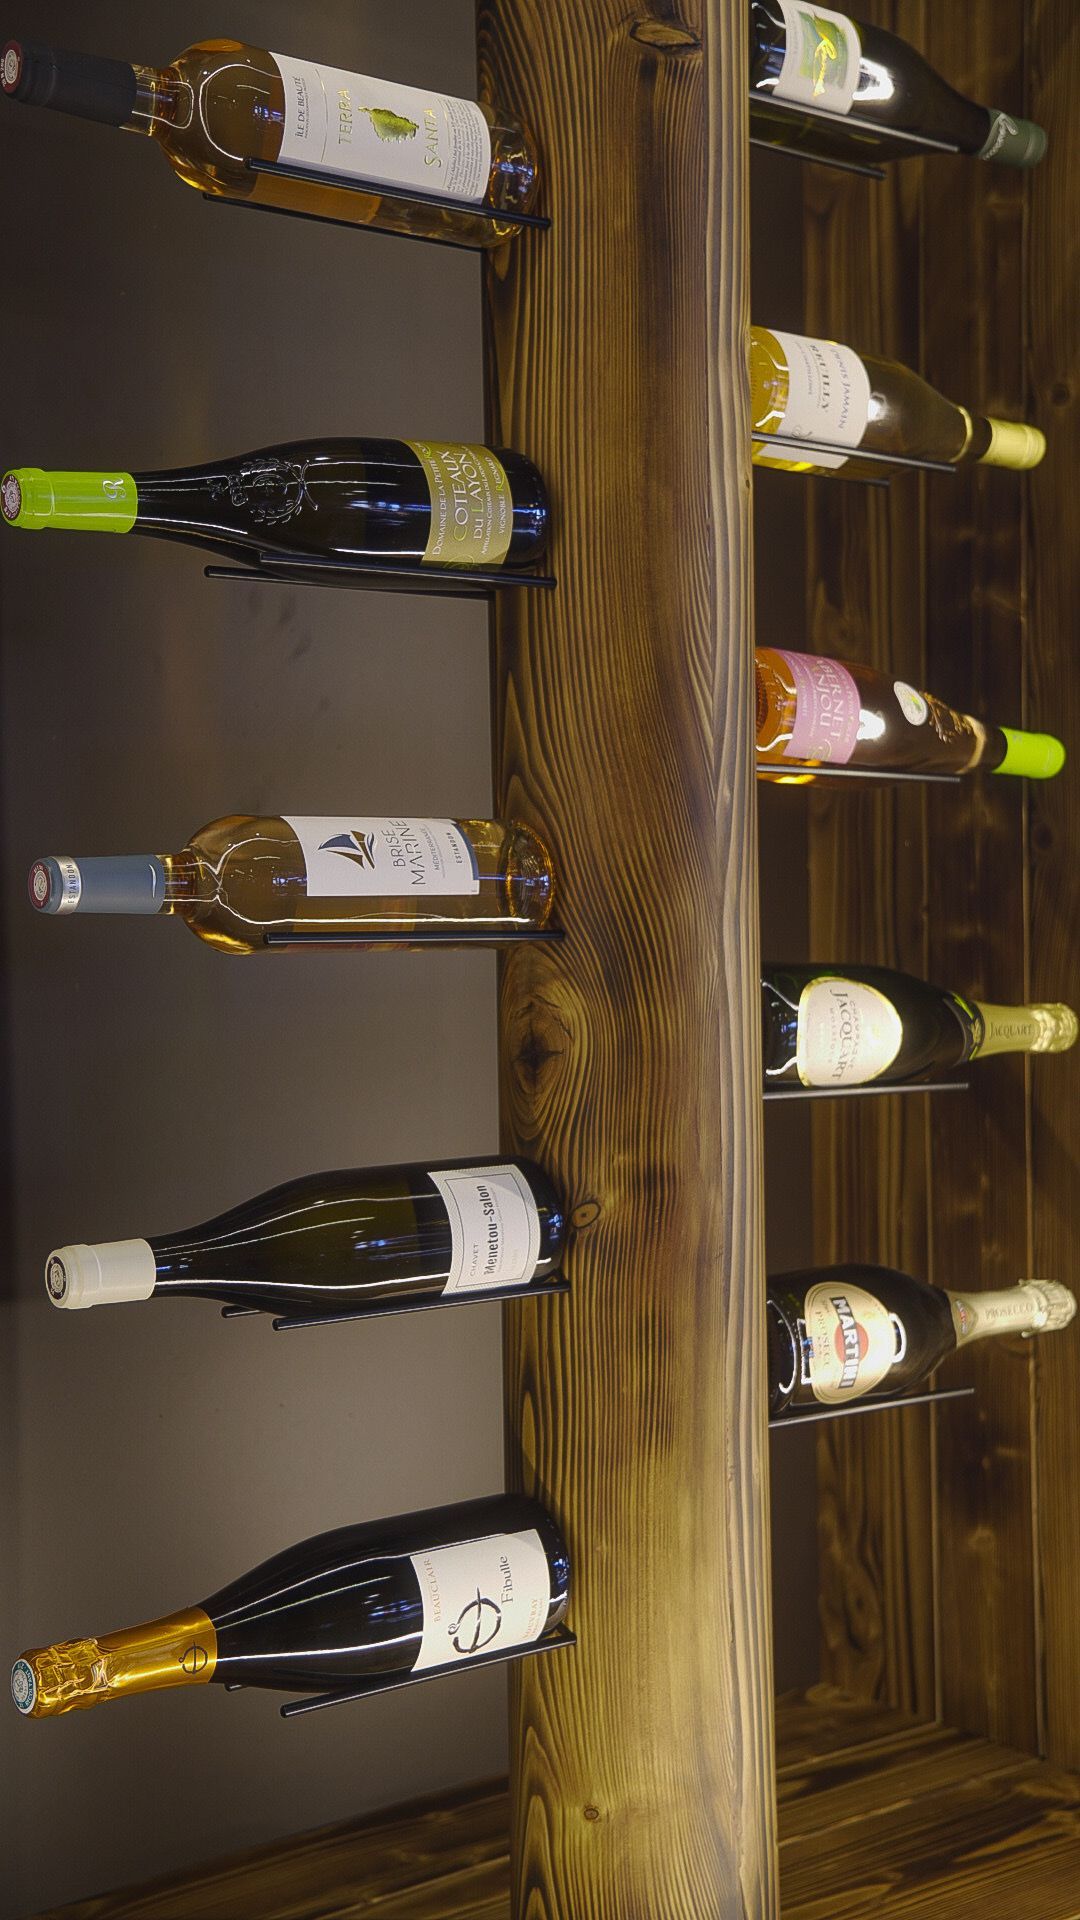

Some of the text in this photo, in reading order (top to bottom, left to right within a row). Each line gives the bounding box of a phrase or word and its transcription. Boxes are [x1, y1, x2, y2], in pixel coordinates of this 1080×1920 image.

[292, 76, 304, 107] BEAUTÉ
[297, 108, 305, 122] DE
[337, 88, 353, 145] TERRA
[424, 107, 442, 168] SANTA
[809, 345, 830, 413] REUILLY
[838, 381, 851, 429] JAMAIN
[429, 459, 447, 555] DOMAINE DE LA PETITE
[437, 451, 469, 541] COTEAUX
[453, 452, 484, 512] LAYON
[484, 456, 507, 534] VIGNOBLE REGNARD
[473, 519, 484, 539] DU
[381, 829, 407, 867] BRISE
[388, 820, 427, 885] MARINE
[65, 863, 77, 904] ESTANDON
[830, 989, 853, 1081] JACQUART
[470, 1244, 479, 1276] CHAVET
[476, 1185, 499, 1275] Menetou-Salon
[831, 1298, 860, 1387] MARTINI
[423, 1558, 441, 1623] BEAUCLAIR
[500, 1556, 514, 1604] Fibulle
